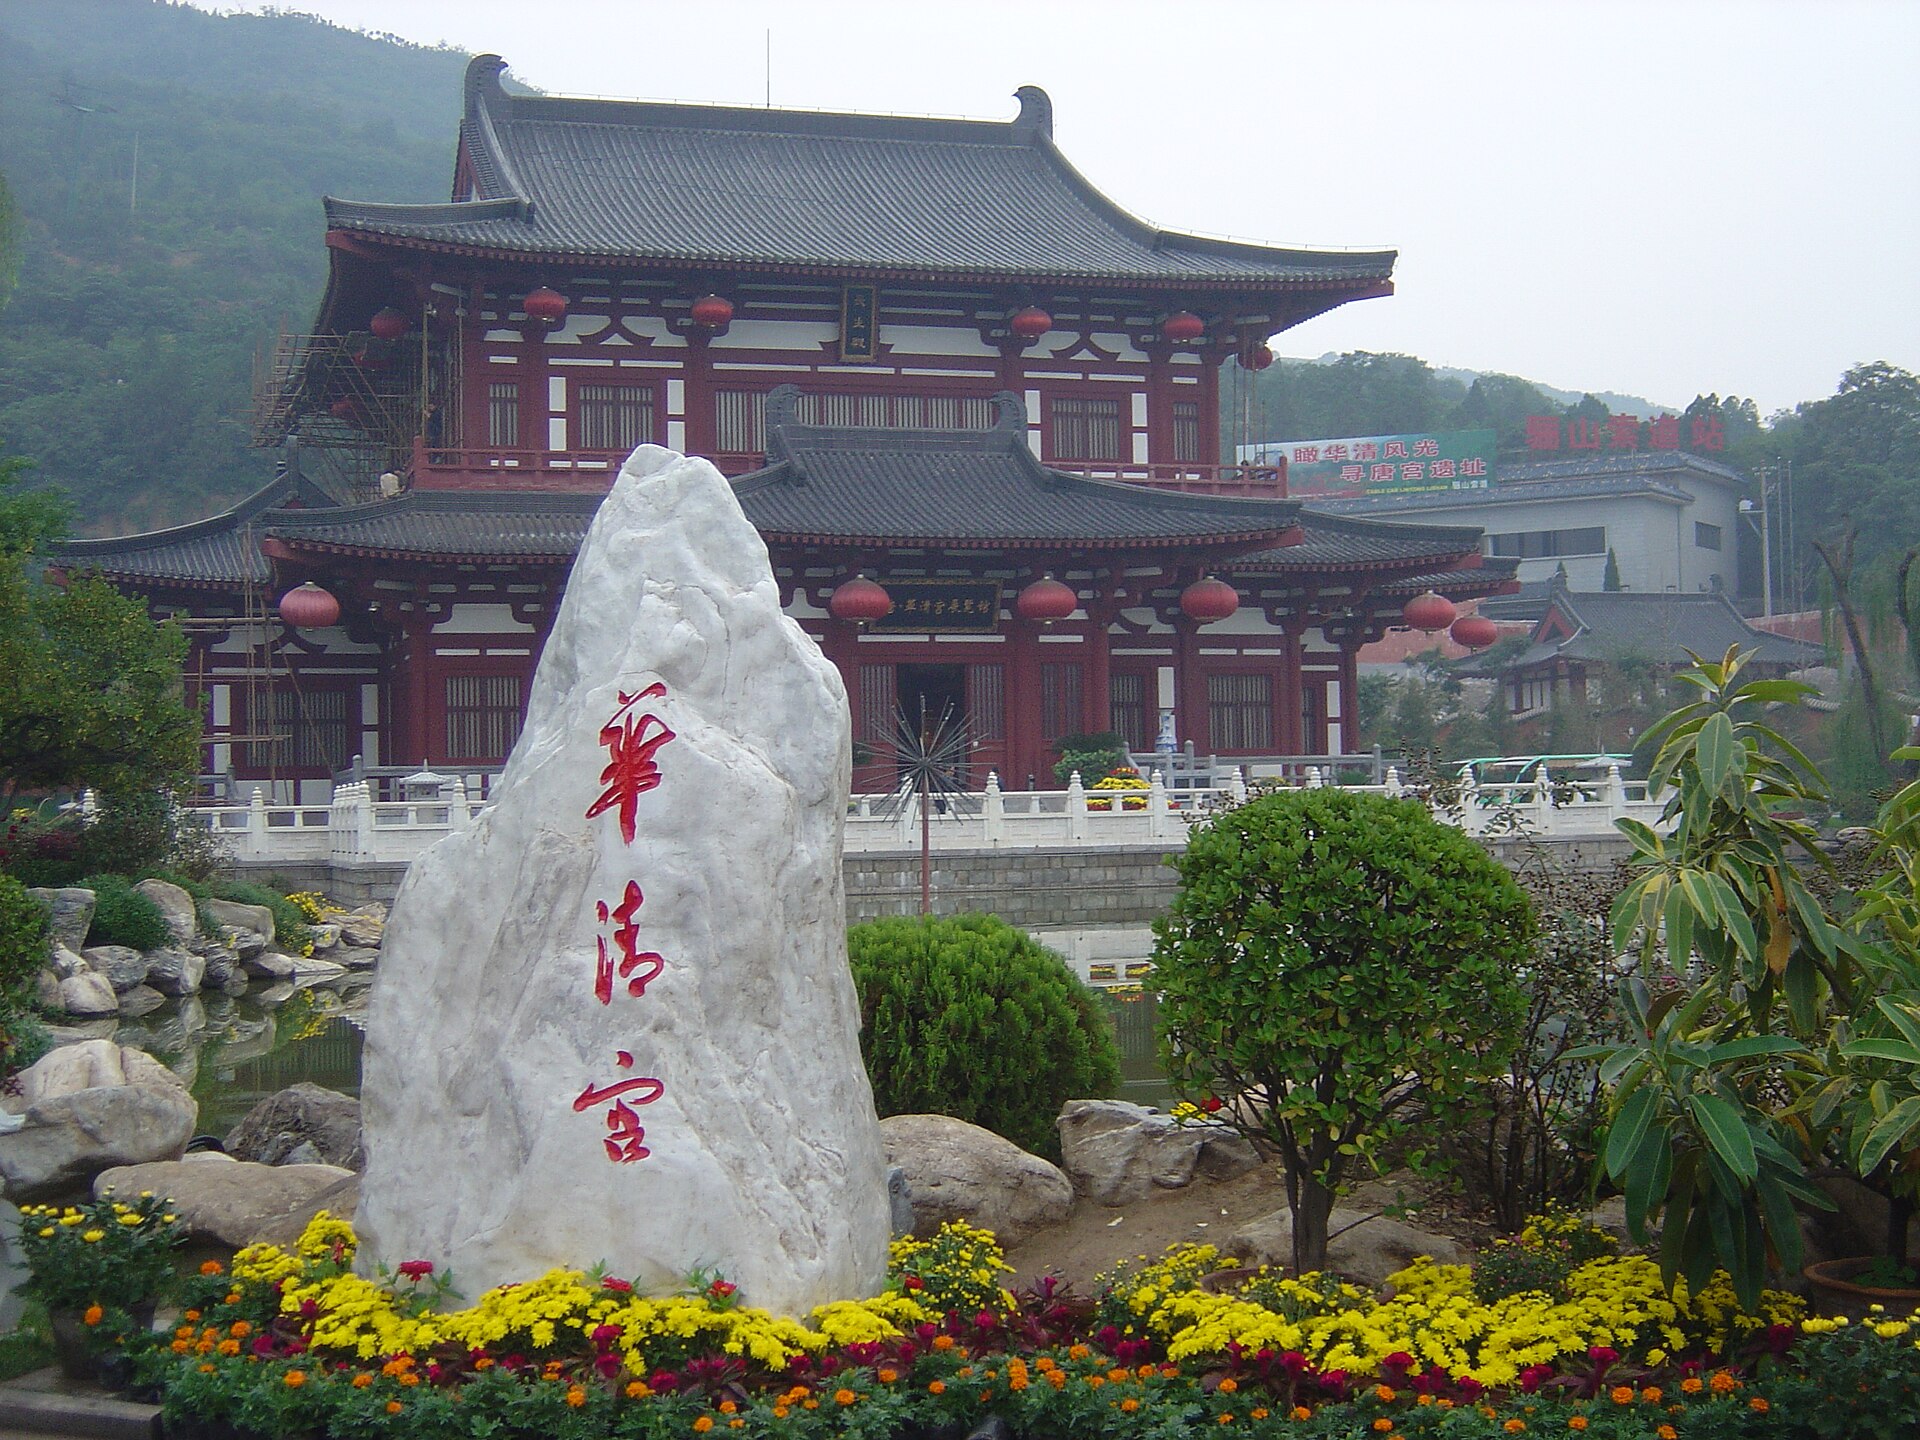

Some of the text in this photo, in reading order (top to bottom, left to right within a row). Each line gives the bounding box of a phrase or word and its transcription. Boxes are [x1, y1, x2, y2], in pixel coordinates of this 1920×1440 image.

[1294, 438, 1440, 464] 瞰华清风光
[1340, 457, 1488, 483] 寻唐宫遗址
